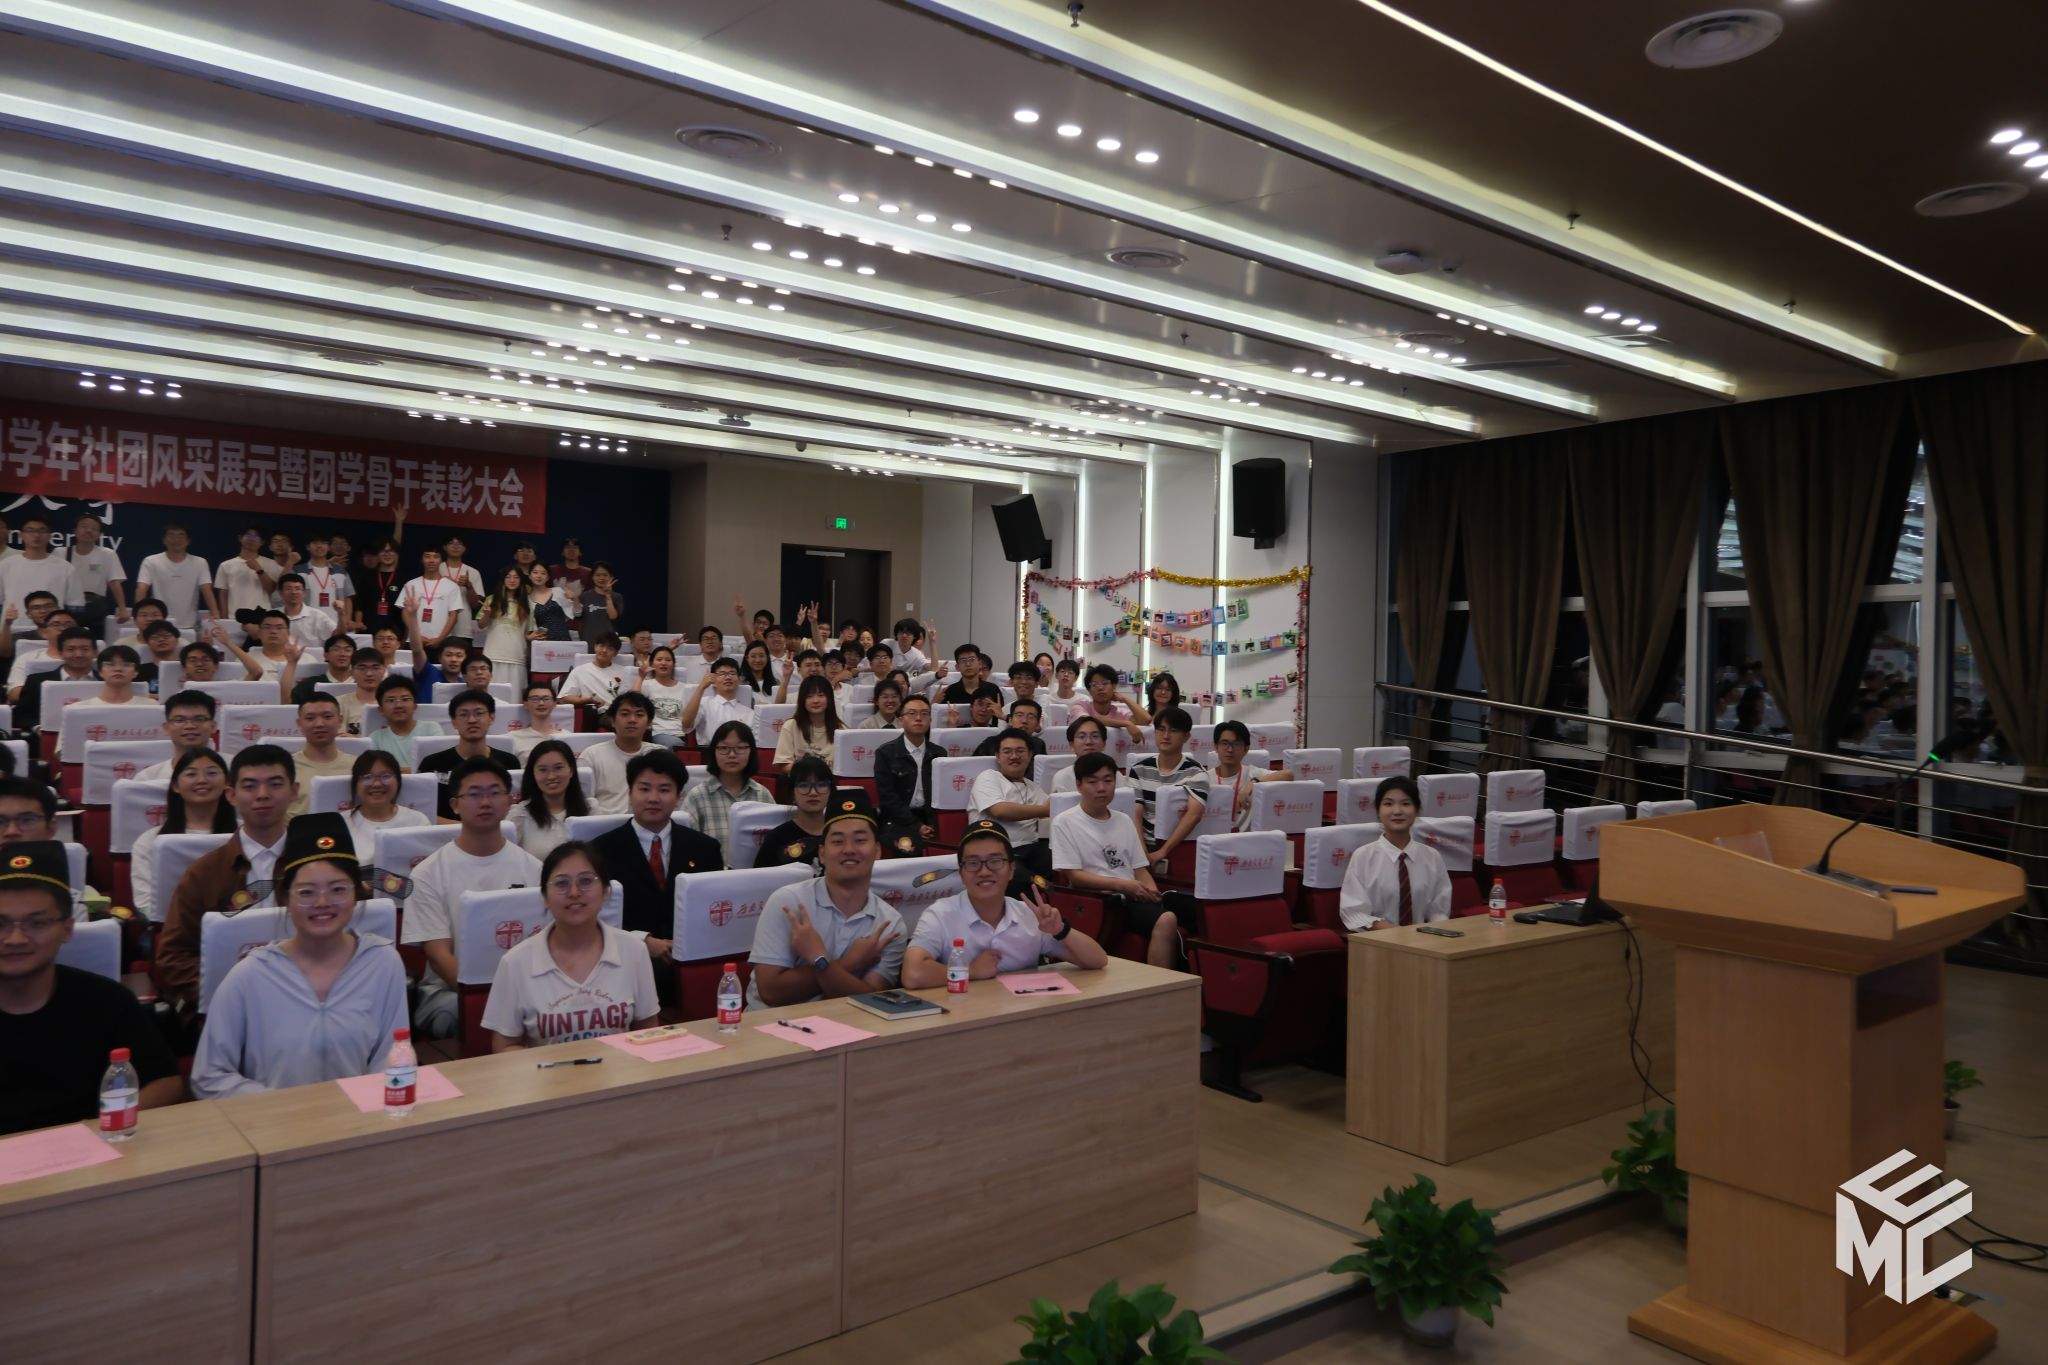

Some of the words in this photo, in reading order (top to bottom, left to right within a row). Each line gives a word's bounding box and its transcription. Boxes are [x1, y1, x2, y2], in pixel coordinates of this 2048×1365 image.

[0, 417, 525, 518] 学年社团风采展示暨团学骨干表彰大会
